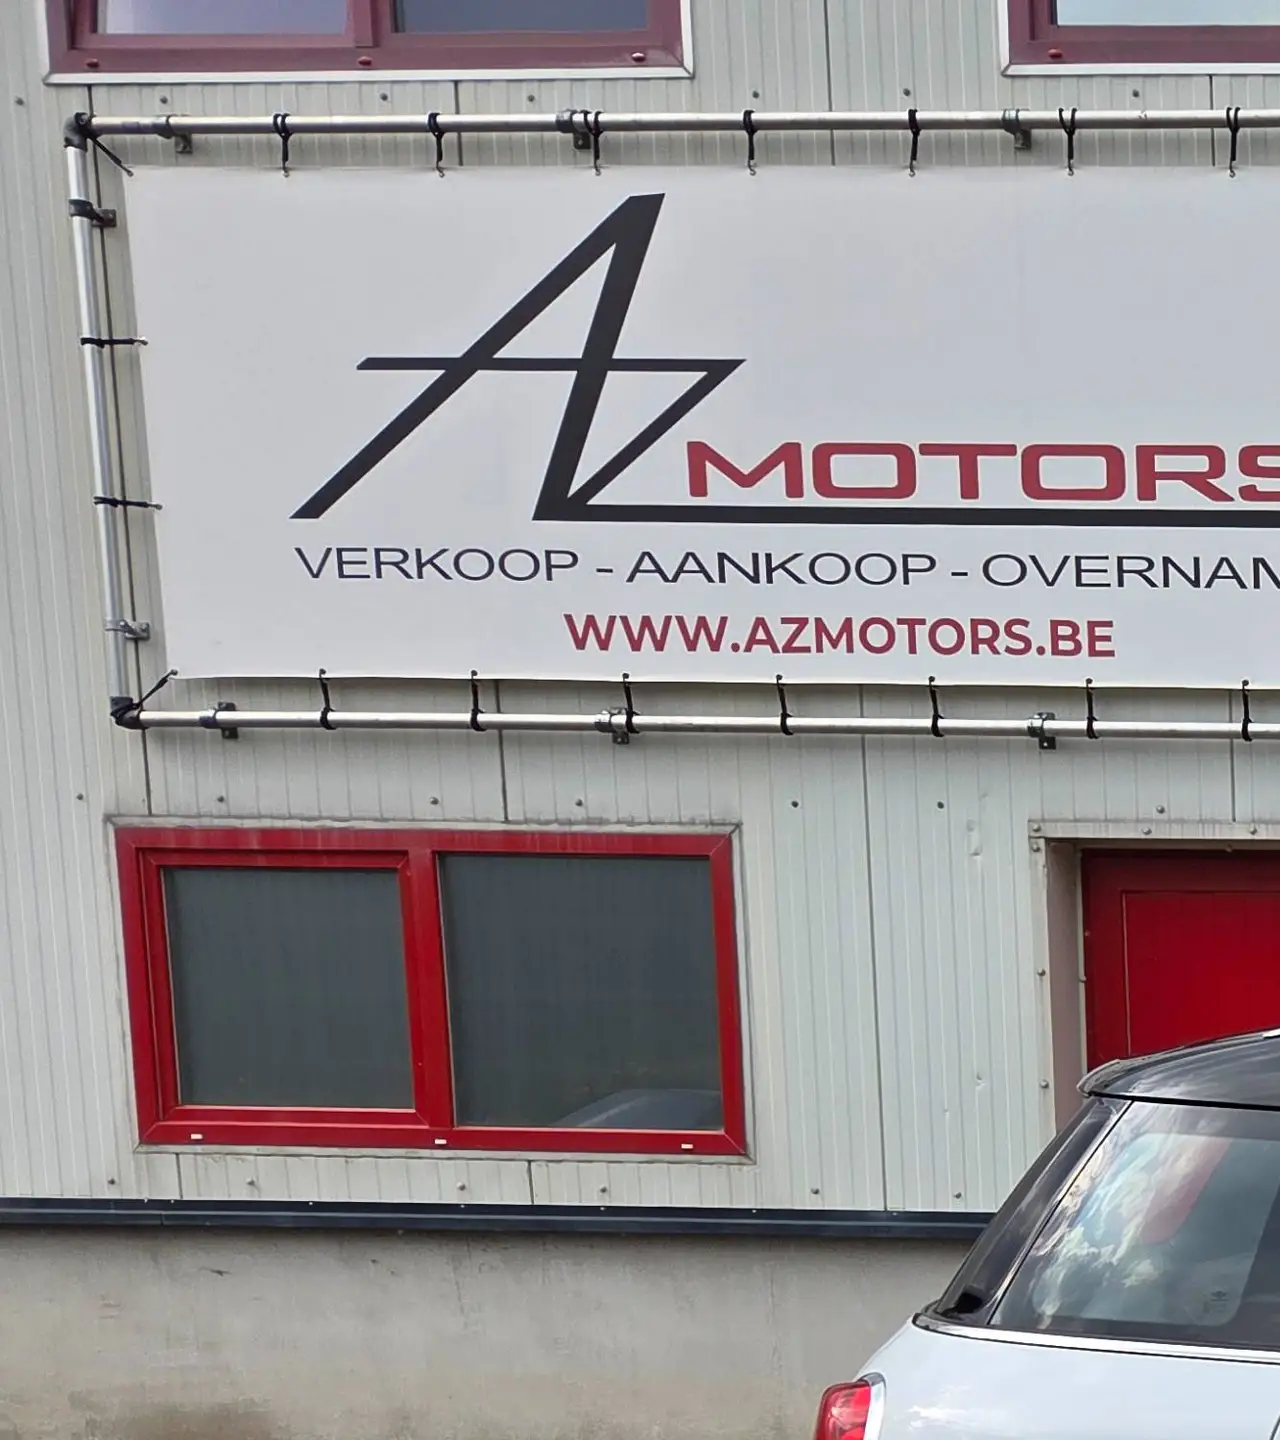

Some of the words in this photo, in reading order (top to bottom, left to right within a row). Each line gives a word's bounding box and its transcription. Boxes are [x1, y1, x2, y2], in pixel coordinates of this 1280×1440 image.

[294, 547, 579, 582] VERKOOP
[626, 551, 937, 587] AANKOOP
[563, 614, 1115, 657] WWW.AZMOTORS.BE
